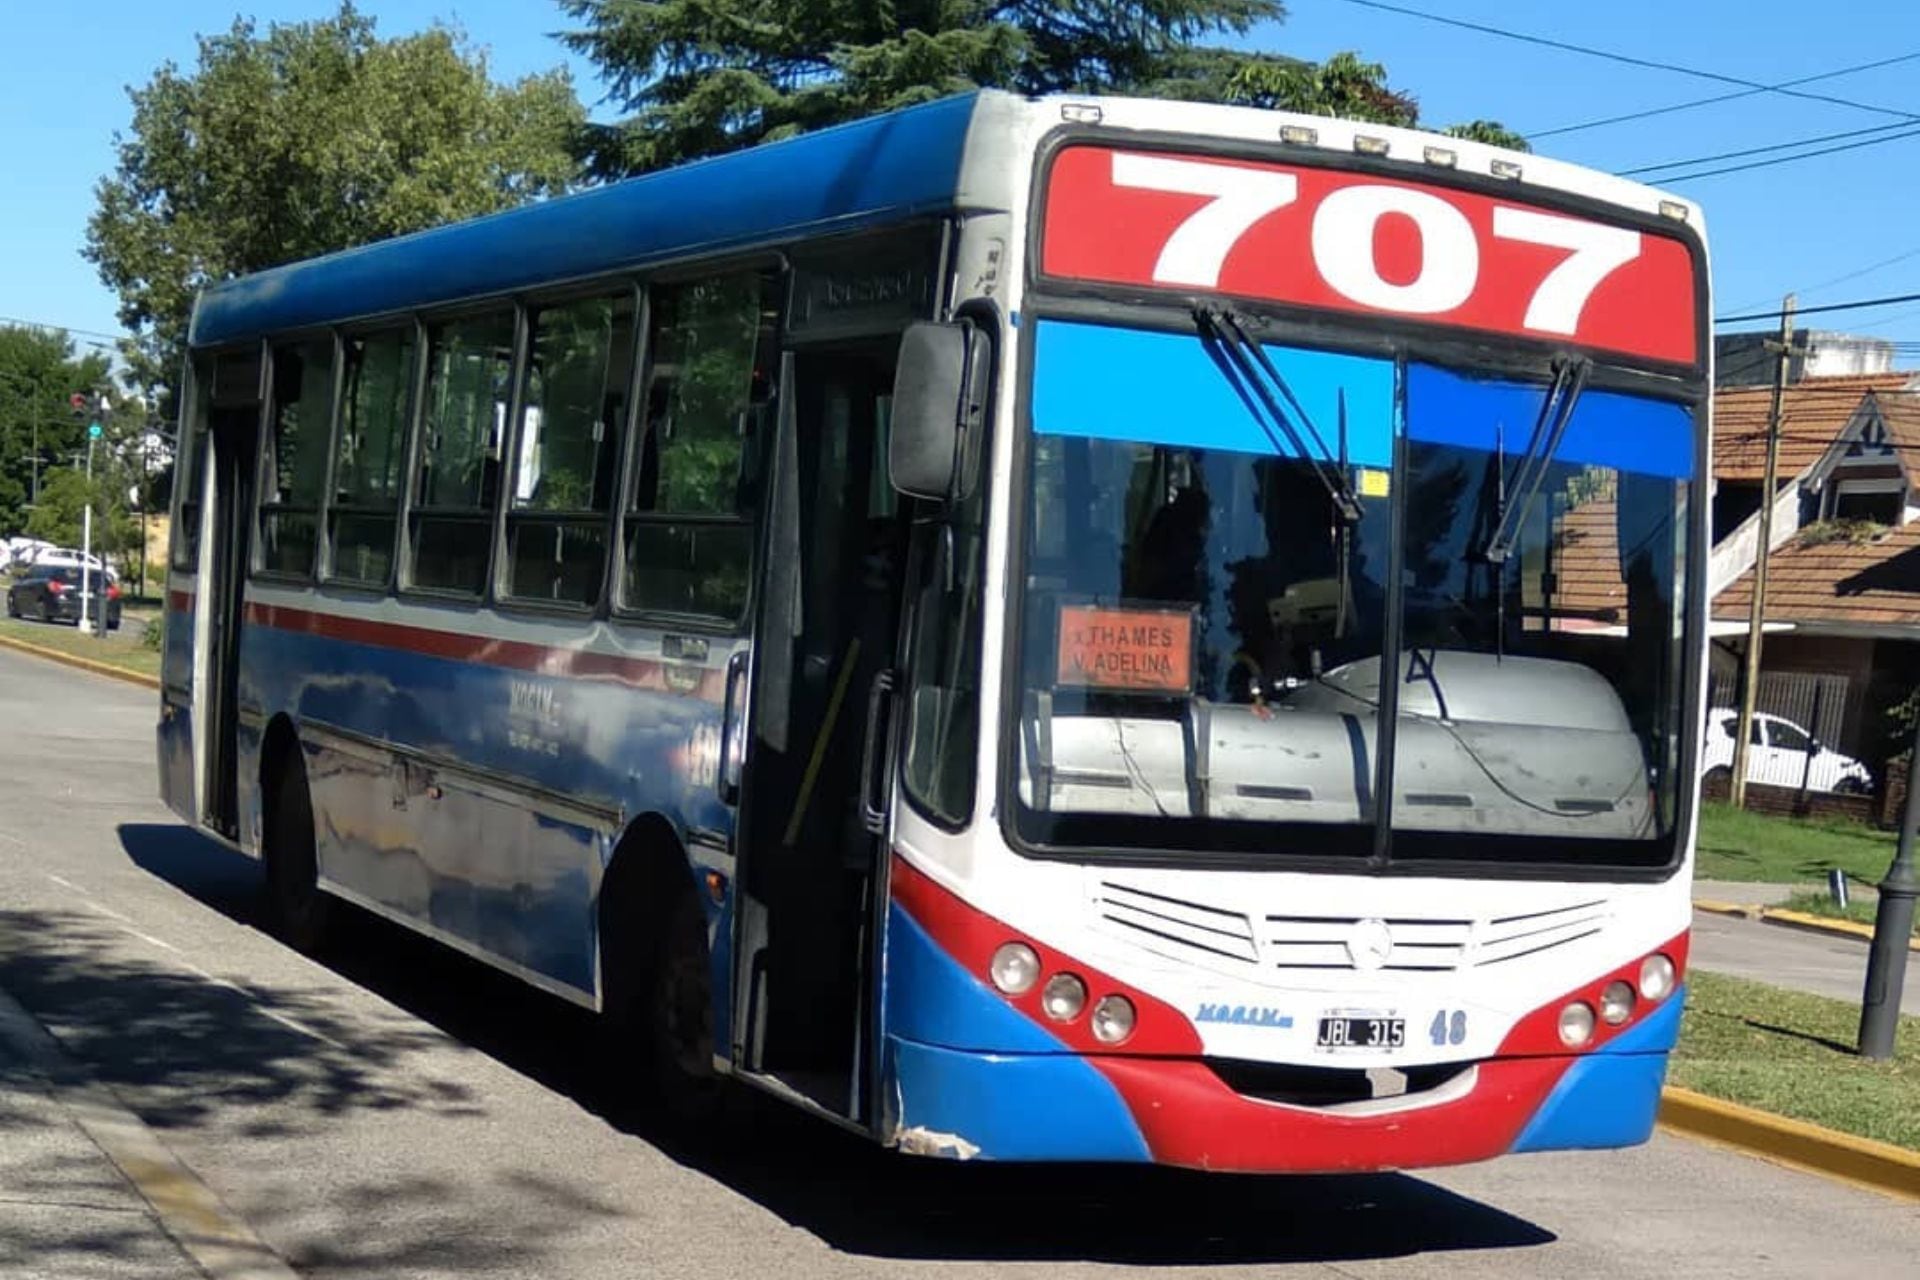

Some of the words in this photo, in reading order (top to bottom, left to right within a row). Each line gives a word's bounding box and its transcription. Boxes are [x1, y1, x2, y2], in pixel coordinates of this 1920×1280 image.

[1111, 151, 1641, 336] 707
[1088, 626, 1173, 648] THAMES
[1095, 652, 1172, 672] ADELINA
[1319, 1019, 1356, 1046] JBL
[1367, 1020, 1405, 1047] 315
[1429, 1009, 1467, 1046] 48
